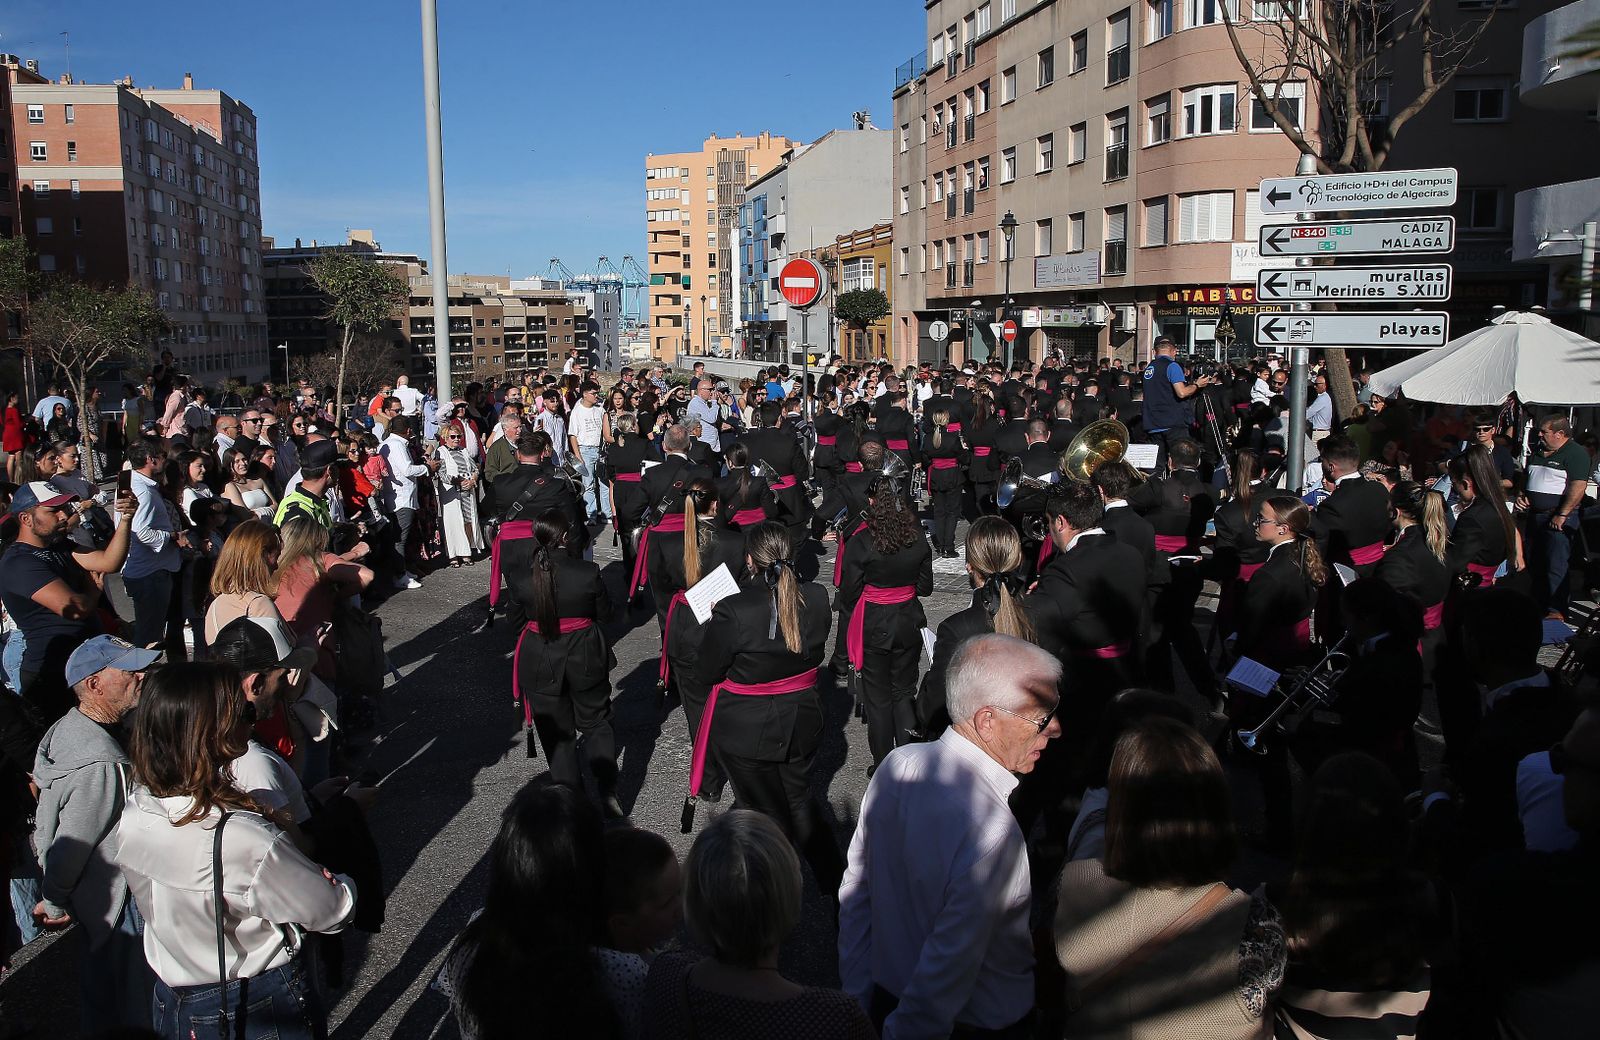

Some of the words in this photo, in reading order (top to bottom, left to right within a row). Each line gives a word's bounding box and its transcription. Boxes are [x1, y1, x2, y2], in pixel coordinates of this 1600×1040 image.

[1325, 181, 1362, 191] Edificio
[1363, 180, 1390, 189] I+D+i
[1391, 178, 1407, 187] del
[1409, 177, 1453, 188] Campus
[1325, 191, 1384, 202] Tecnológico
[1386, 191, 1399, 199] de
[1400, 189, 1449, 200] Algeciras
[1369, 269, 1445, 282] murallas
[1182, 288, 1253, 302] TABAC
[1316, 284, 1386, 297] Meriníes
[1397, 284, 1444, 296] S.XIII
[1187, 306, 1220, 315] PRENSA
[1379, 322, 1442, 338] playas
